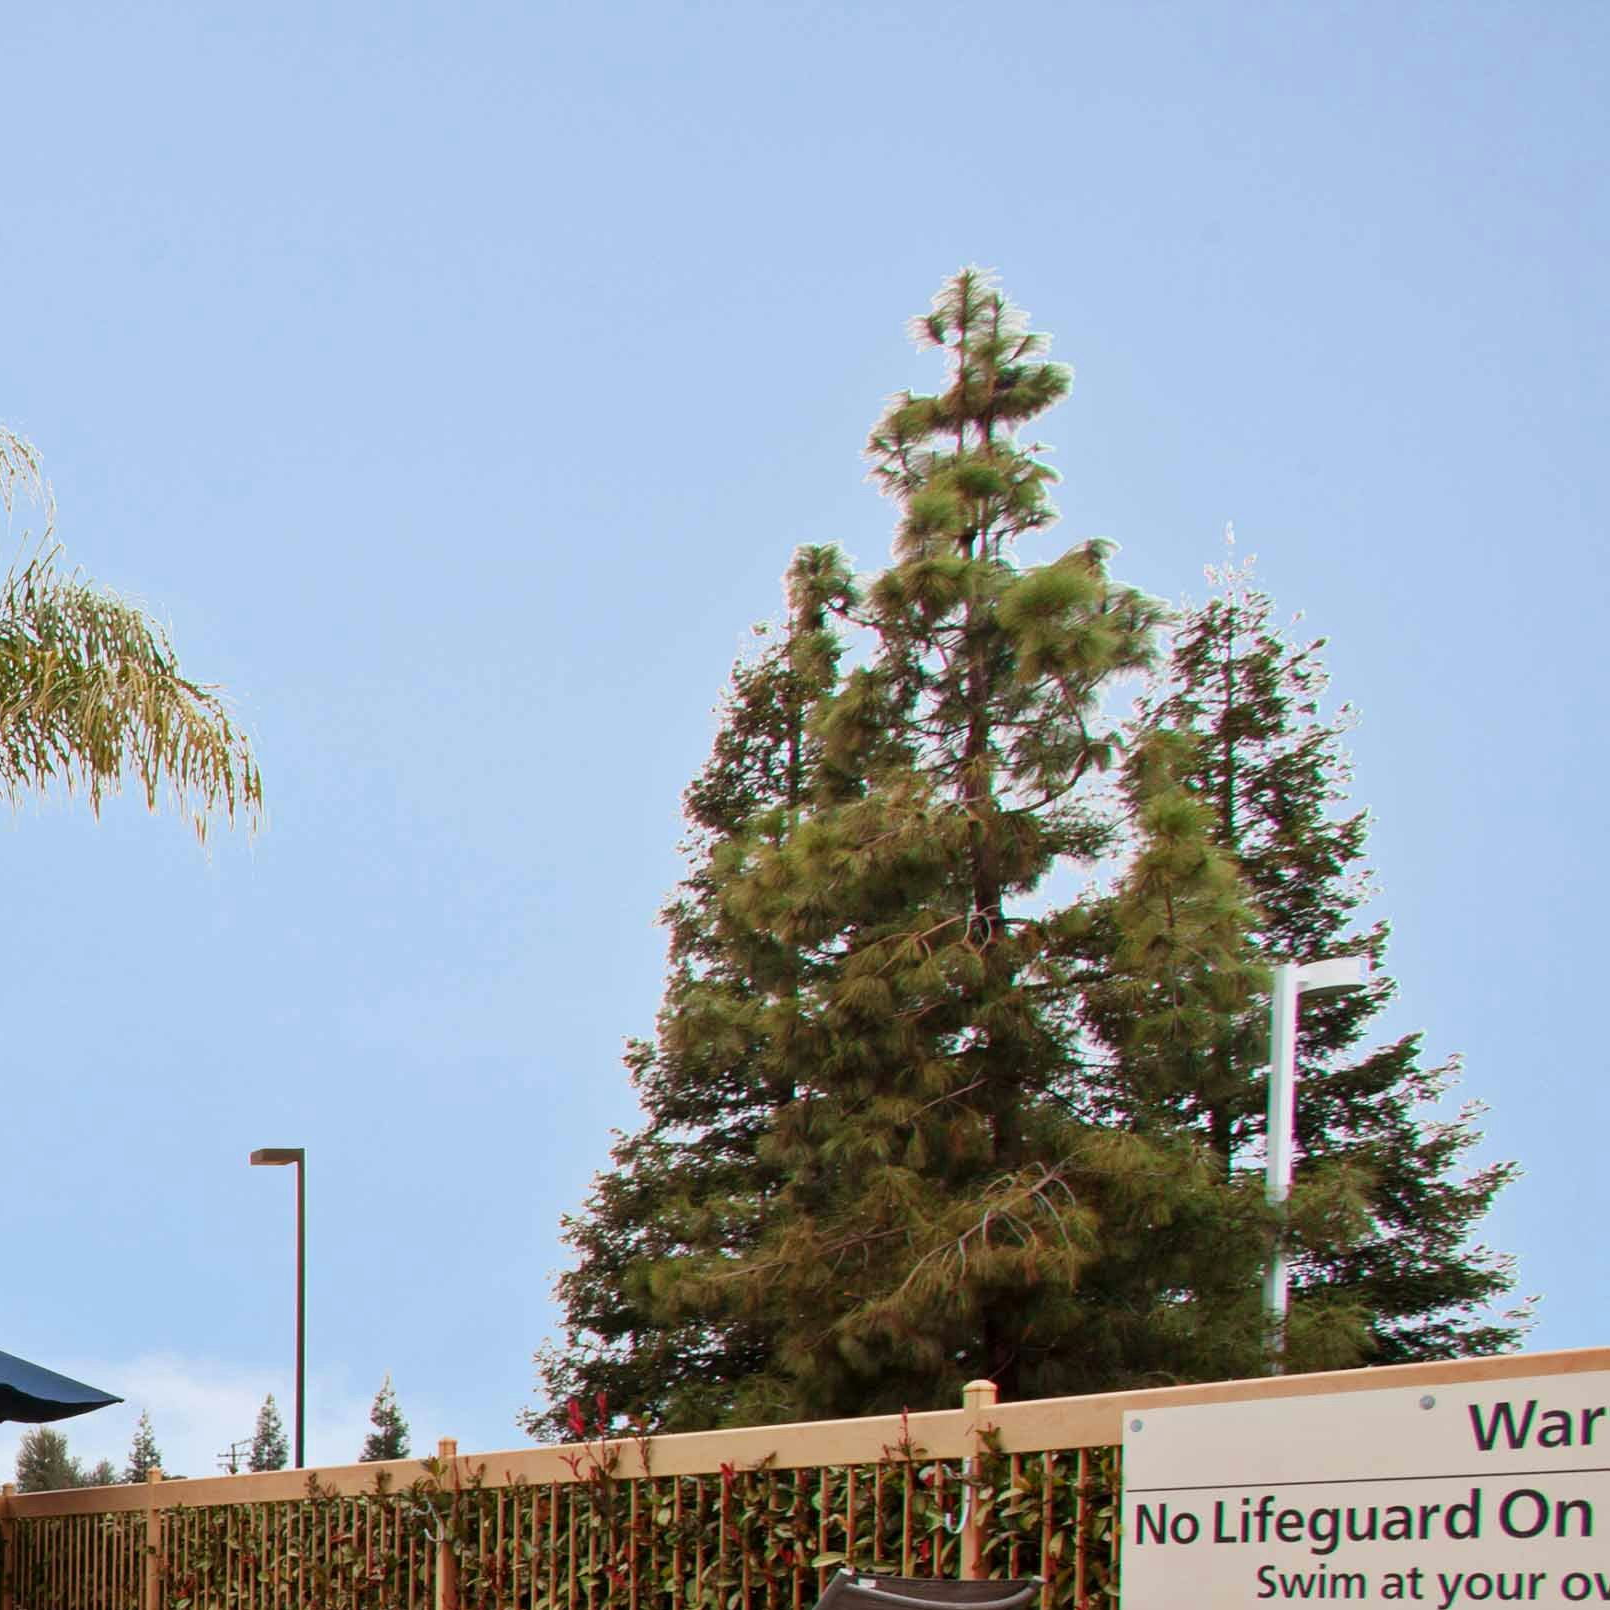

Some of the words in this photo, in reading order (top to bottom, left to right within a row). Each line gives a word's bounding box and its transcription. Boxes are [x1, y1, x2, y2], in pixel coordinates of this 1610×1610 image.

[1468, 1399, 1607, 1452] War
[1135, 1503, 1200, 1546] No
[1213, 1488, 1482, 1556] Lifeguard
[1498, 1488, 1594, 1540] On
[1256, 1563, 1366, 1600] Swim
[1380, 1567, 1425, 1600] at
[1436, 1573, 1547, 1610] your
